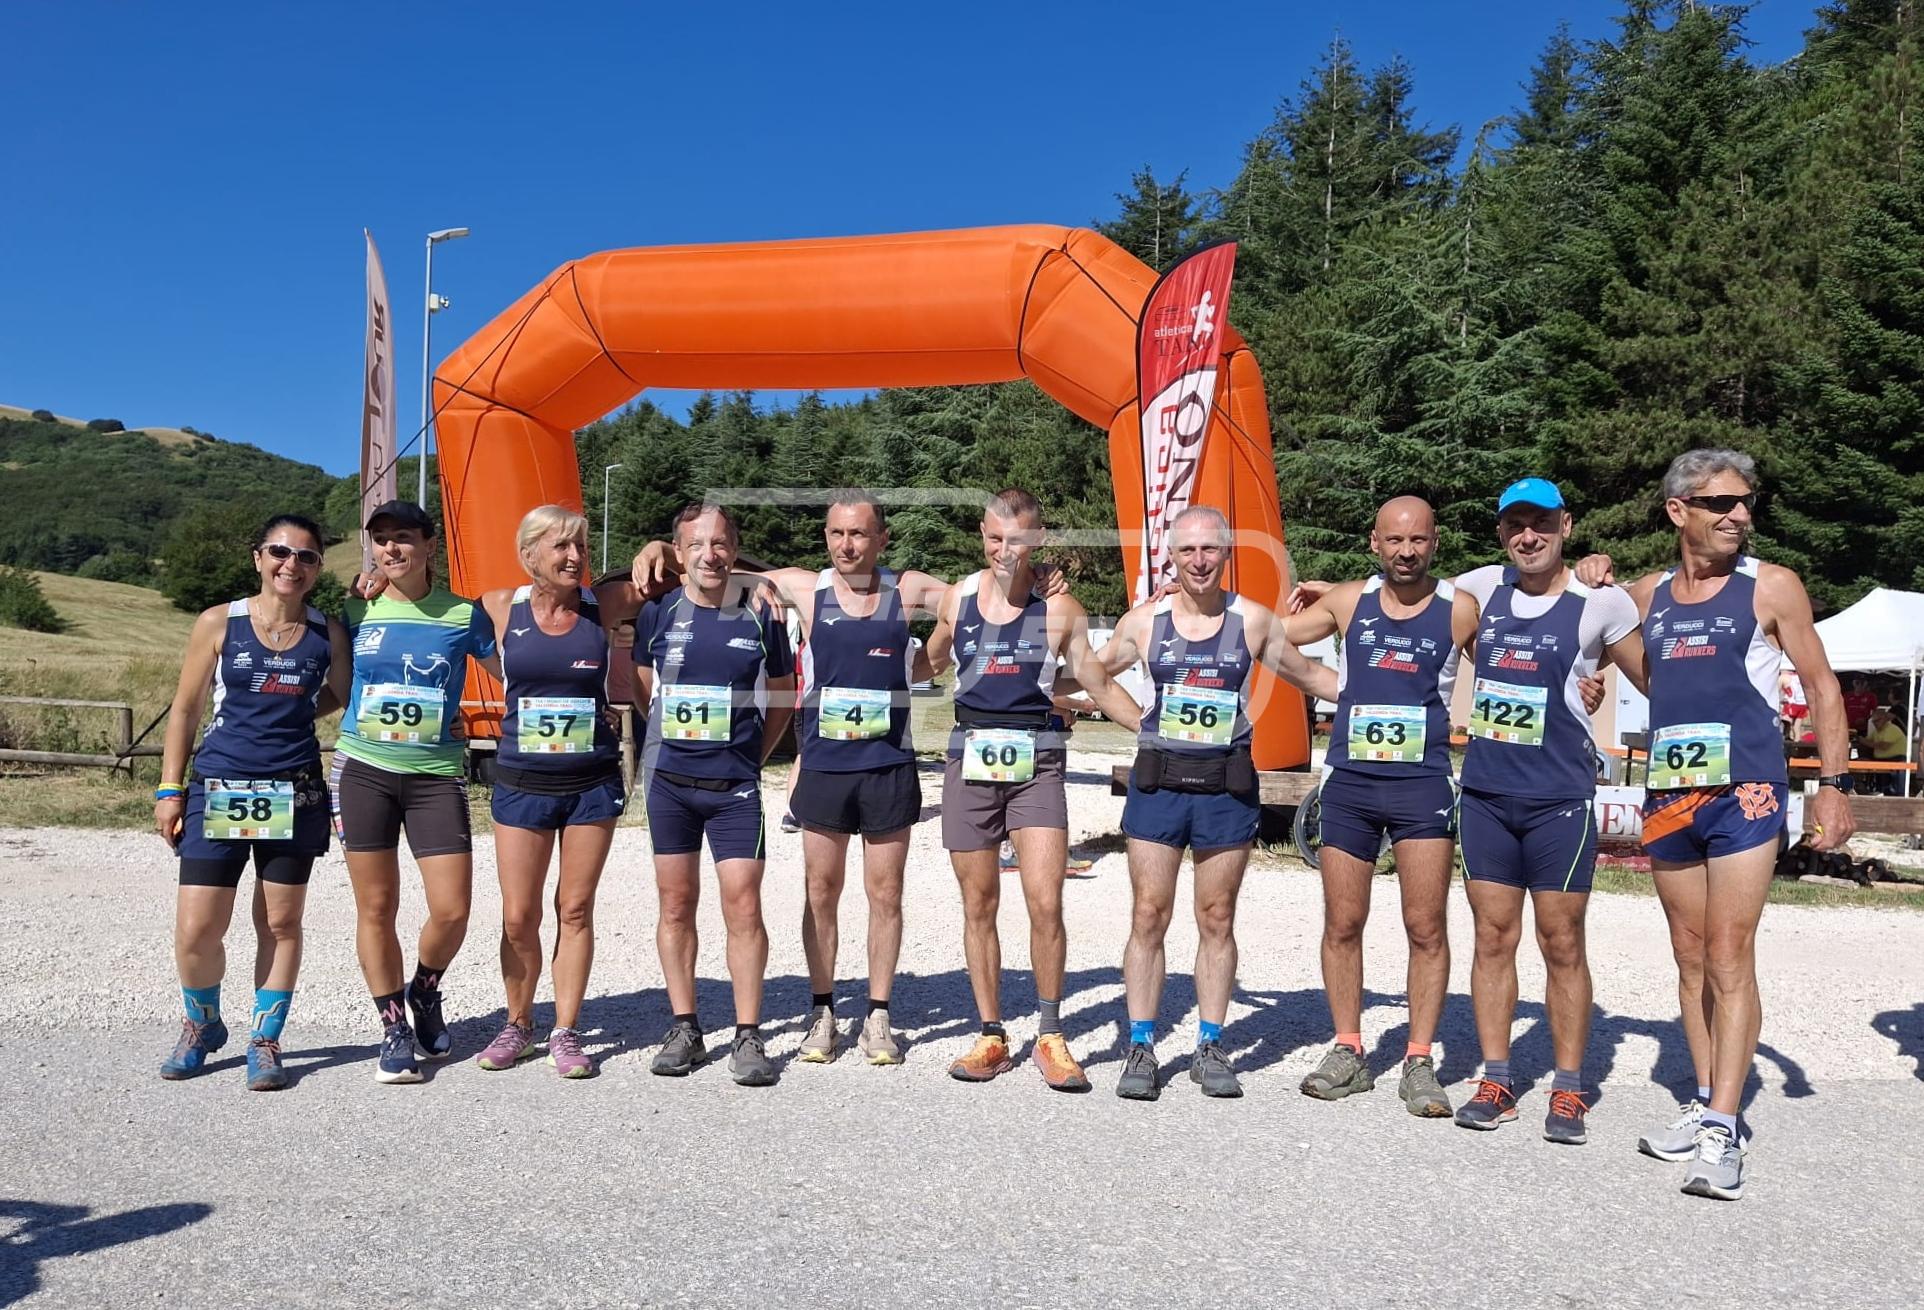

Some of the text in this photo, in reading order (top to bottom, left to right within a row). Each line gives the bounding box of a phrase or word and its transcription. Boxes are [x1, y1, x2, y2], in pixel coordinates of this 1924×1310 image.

[1154, 325, 1193, 338] atletica
[1684, 645, 1717, 657] RUNNERS
[1687, 635, 1709, 646] ASSISI
[278, 674, 301, 685] ASSISI
[379, 701, 423, 727] 59
[676, 701, 709, 724] 61
[845, 703, 864, 726] 4
[1179, 702, 1218, 728] 56
[1480, 697, 1535, 729] 122
[538, 714, 577, 738] 57
[1366, 721, 1406, 746] 63
[981, 744, 1017, 767] 60
[1666, 742, 1709, 770] 62
[226, 797, 272, 822] 58
